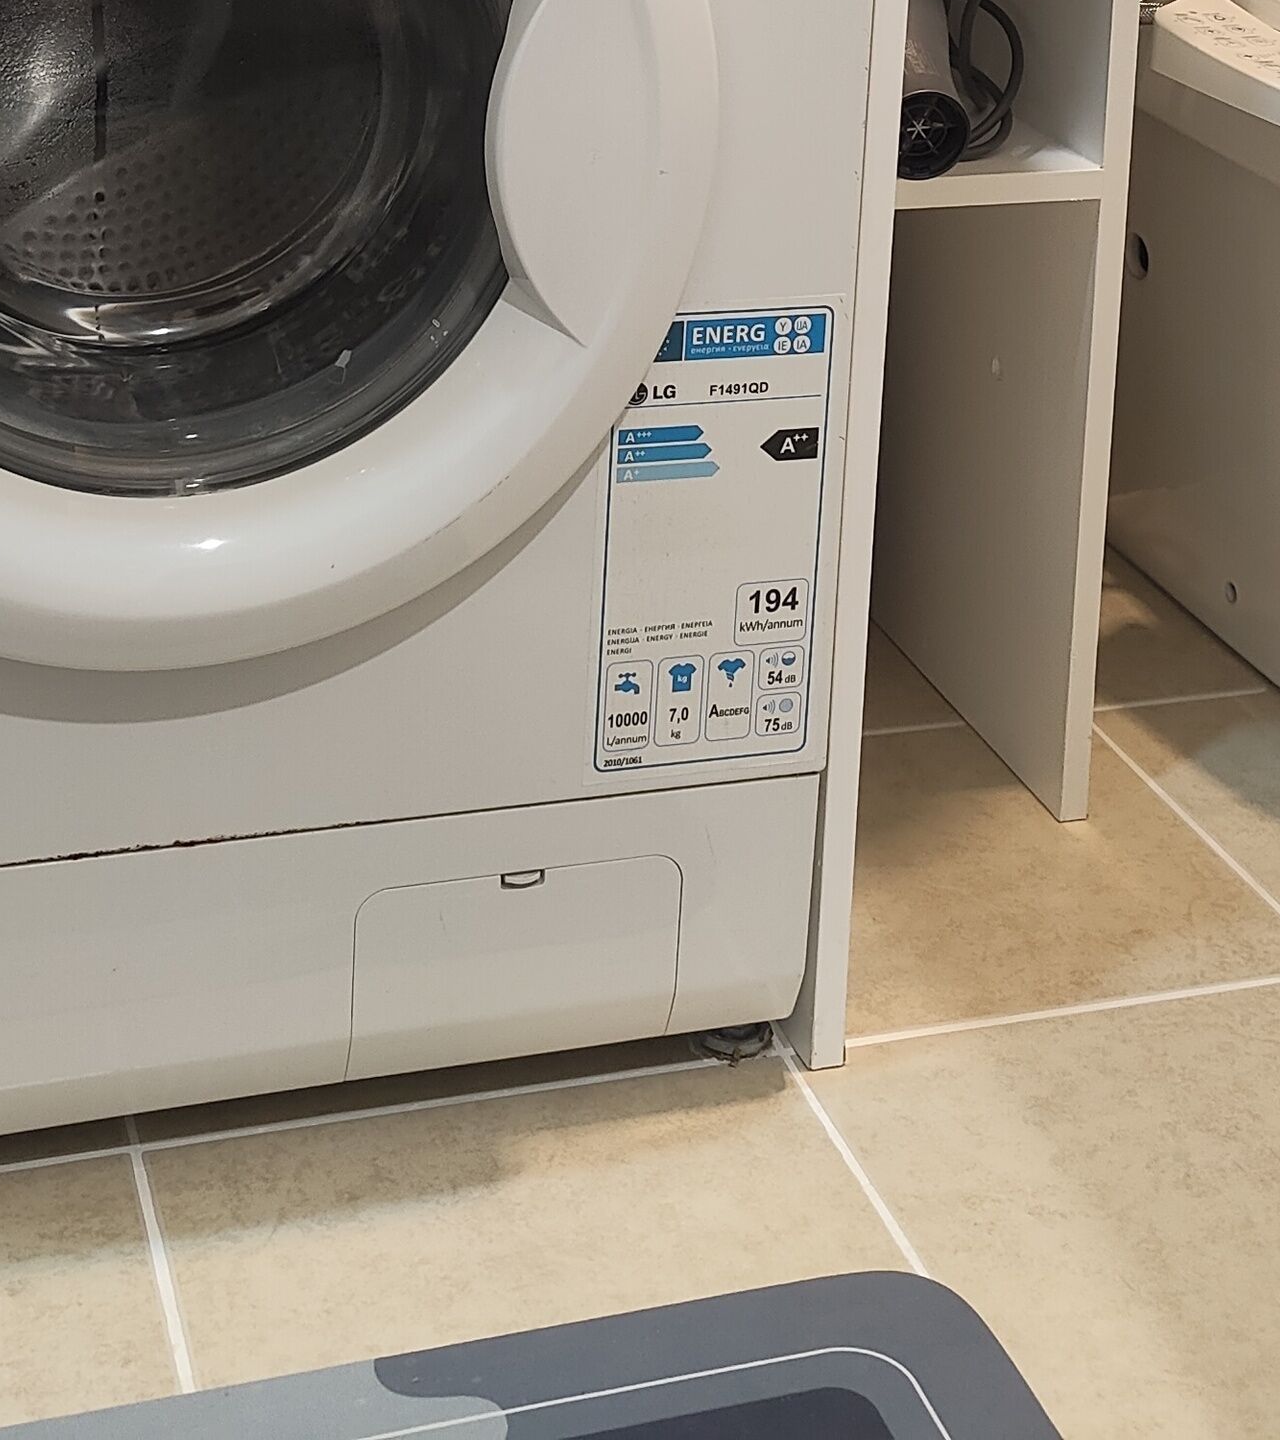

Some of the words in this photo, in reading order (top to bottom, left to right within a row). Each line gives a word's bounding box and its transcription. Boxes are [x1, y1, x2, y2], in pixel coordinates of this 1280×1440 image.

[692, 323, 766, 345] ENERG
[778, 341, 788, 351] IE
[797, 338, 807, 349] IA
[652, 384, 677, 400] LG
[709, 381, 770, 397] F1491QD
[625, 430, 653, 444] A+++
[779, 432, 810, 454] A++
[624, 449, 646, 463] A++
[623, 469, 640, 481] A+
[748, 586, 800, 615] 194
[607, 627, 638, 636] ENERGIA
[739, 618, 804, 633] kWh/annum
[646, 633, 674, 643] ENERGY
[679, 630, 708, 640] ENERGIE
[606, 648, 632, 656] ENERGI
[677, 674, 688, 685] kg
[766, 670, 783, 686] 54
[784, 673, 797, 684] dB
[607, 710, 648, 729] 10000
[669, 706, 690, 724] 7,0
[764, 718, 781, 733] 75
[781, 720, 794, 732] dB
[606, 734, 648, 747] L/annum
[670, 728, 682, 740] kg
